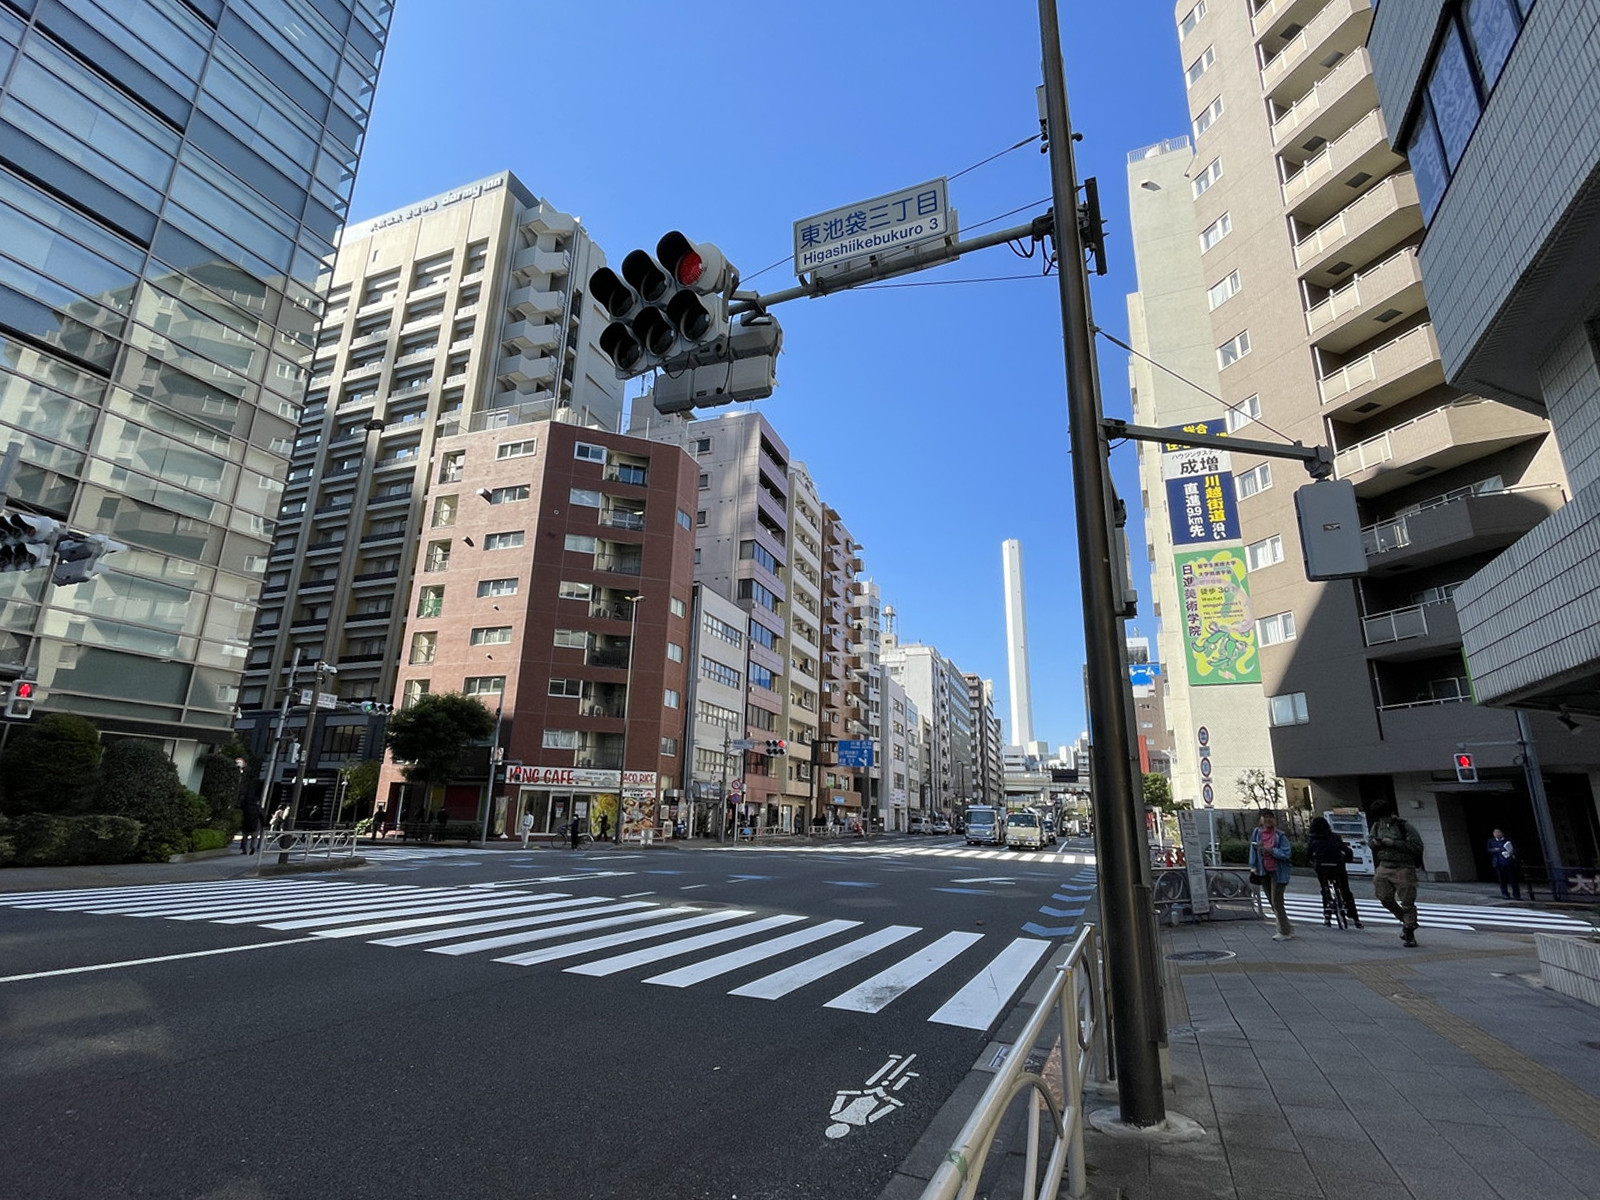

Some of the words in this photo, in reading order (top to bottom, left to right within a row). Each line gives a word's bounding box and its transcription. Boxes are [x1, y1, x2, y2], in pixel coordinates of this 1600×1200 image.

[442, 184, 483, 205] dormy
[800, 189, 938, 249] 東池袋三丁目
[803, 224, 924, 265] Higashiikebukuro
[929, 217, 939, 230] 3
[1180, 456, 1219, 475] 成増
[1182, 564, 1201, 637] 日進美術学院
[509, 767, 540, 783] KNG
[543, 769, 574, 785] CAFE
[619, 772, 638, 783] ACO
